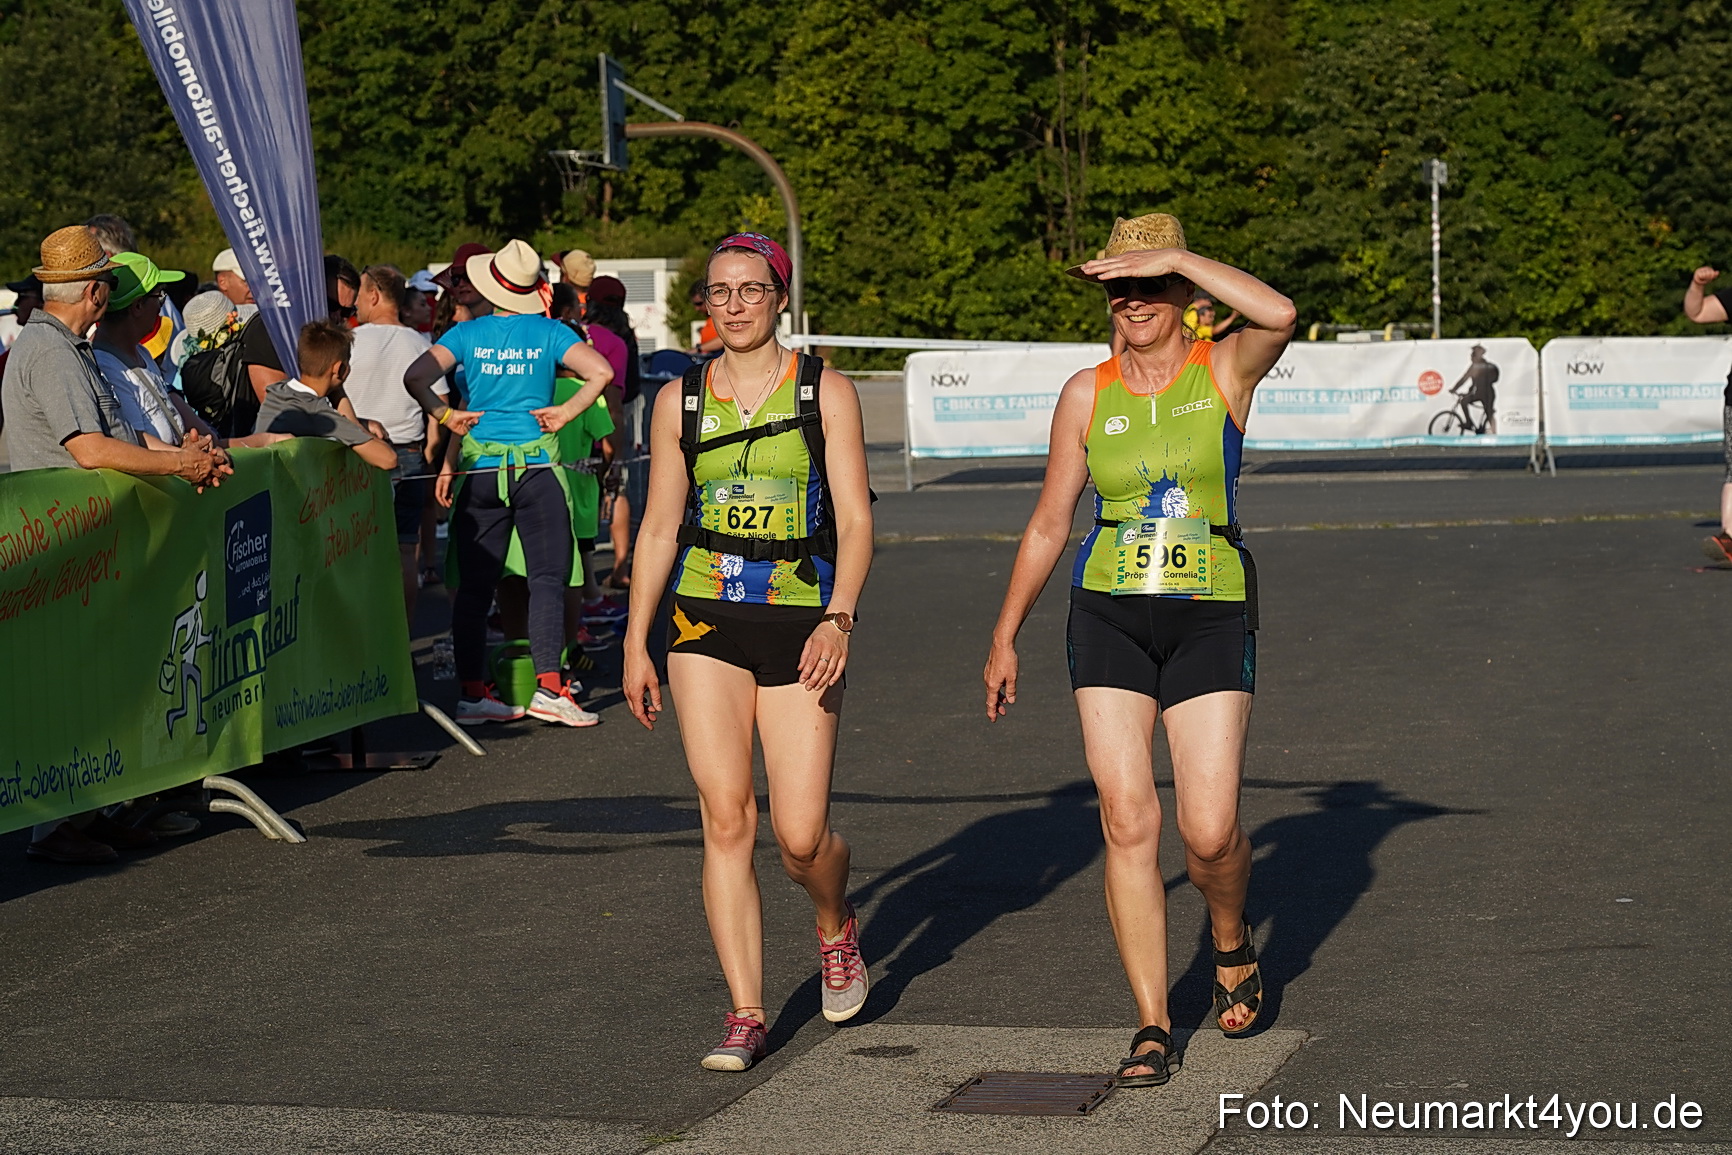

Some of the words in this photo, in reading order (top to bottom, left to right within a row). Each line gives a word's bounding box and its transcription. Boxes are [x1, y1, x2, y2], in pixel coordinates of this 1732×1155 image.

[474, 347, 495, 359] Hier
[497, 347, 524, 361] blüht
[526, 348, 543, 359] ihr
[506, 362, 527, 375] auf
[1265, 366, 1296, 379] OW
[1567, 361, 1605, 375] NOW
[931, 373, 970, 387] NOW
[1260, 391, 1316, 403] E-BIKES
[1319, 391, 1329, 403] &
[1627, 386, 1639, 398] &
[995, 397, 1006, 409] &
[1172, 398, 1213, 417] BOCK
[47, 495, 113, 548] Firmen
[727, 505, 774, 530] 627
[786, 507, 796, 540] 2022
[748, 531, 777, 540] Nicole
[232, 533, 268, 564] Fischer
[1136, 543, 1187, 569] 596
[52, 529, 121, 607] länger!
[1117, 549, 1126, 585] WALK
[1197, 549, 1207, 582] 2022
[1163, 570, 1199, 579] Cornelia
